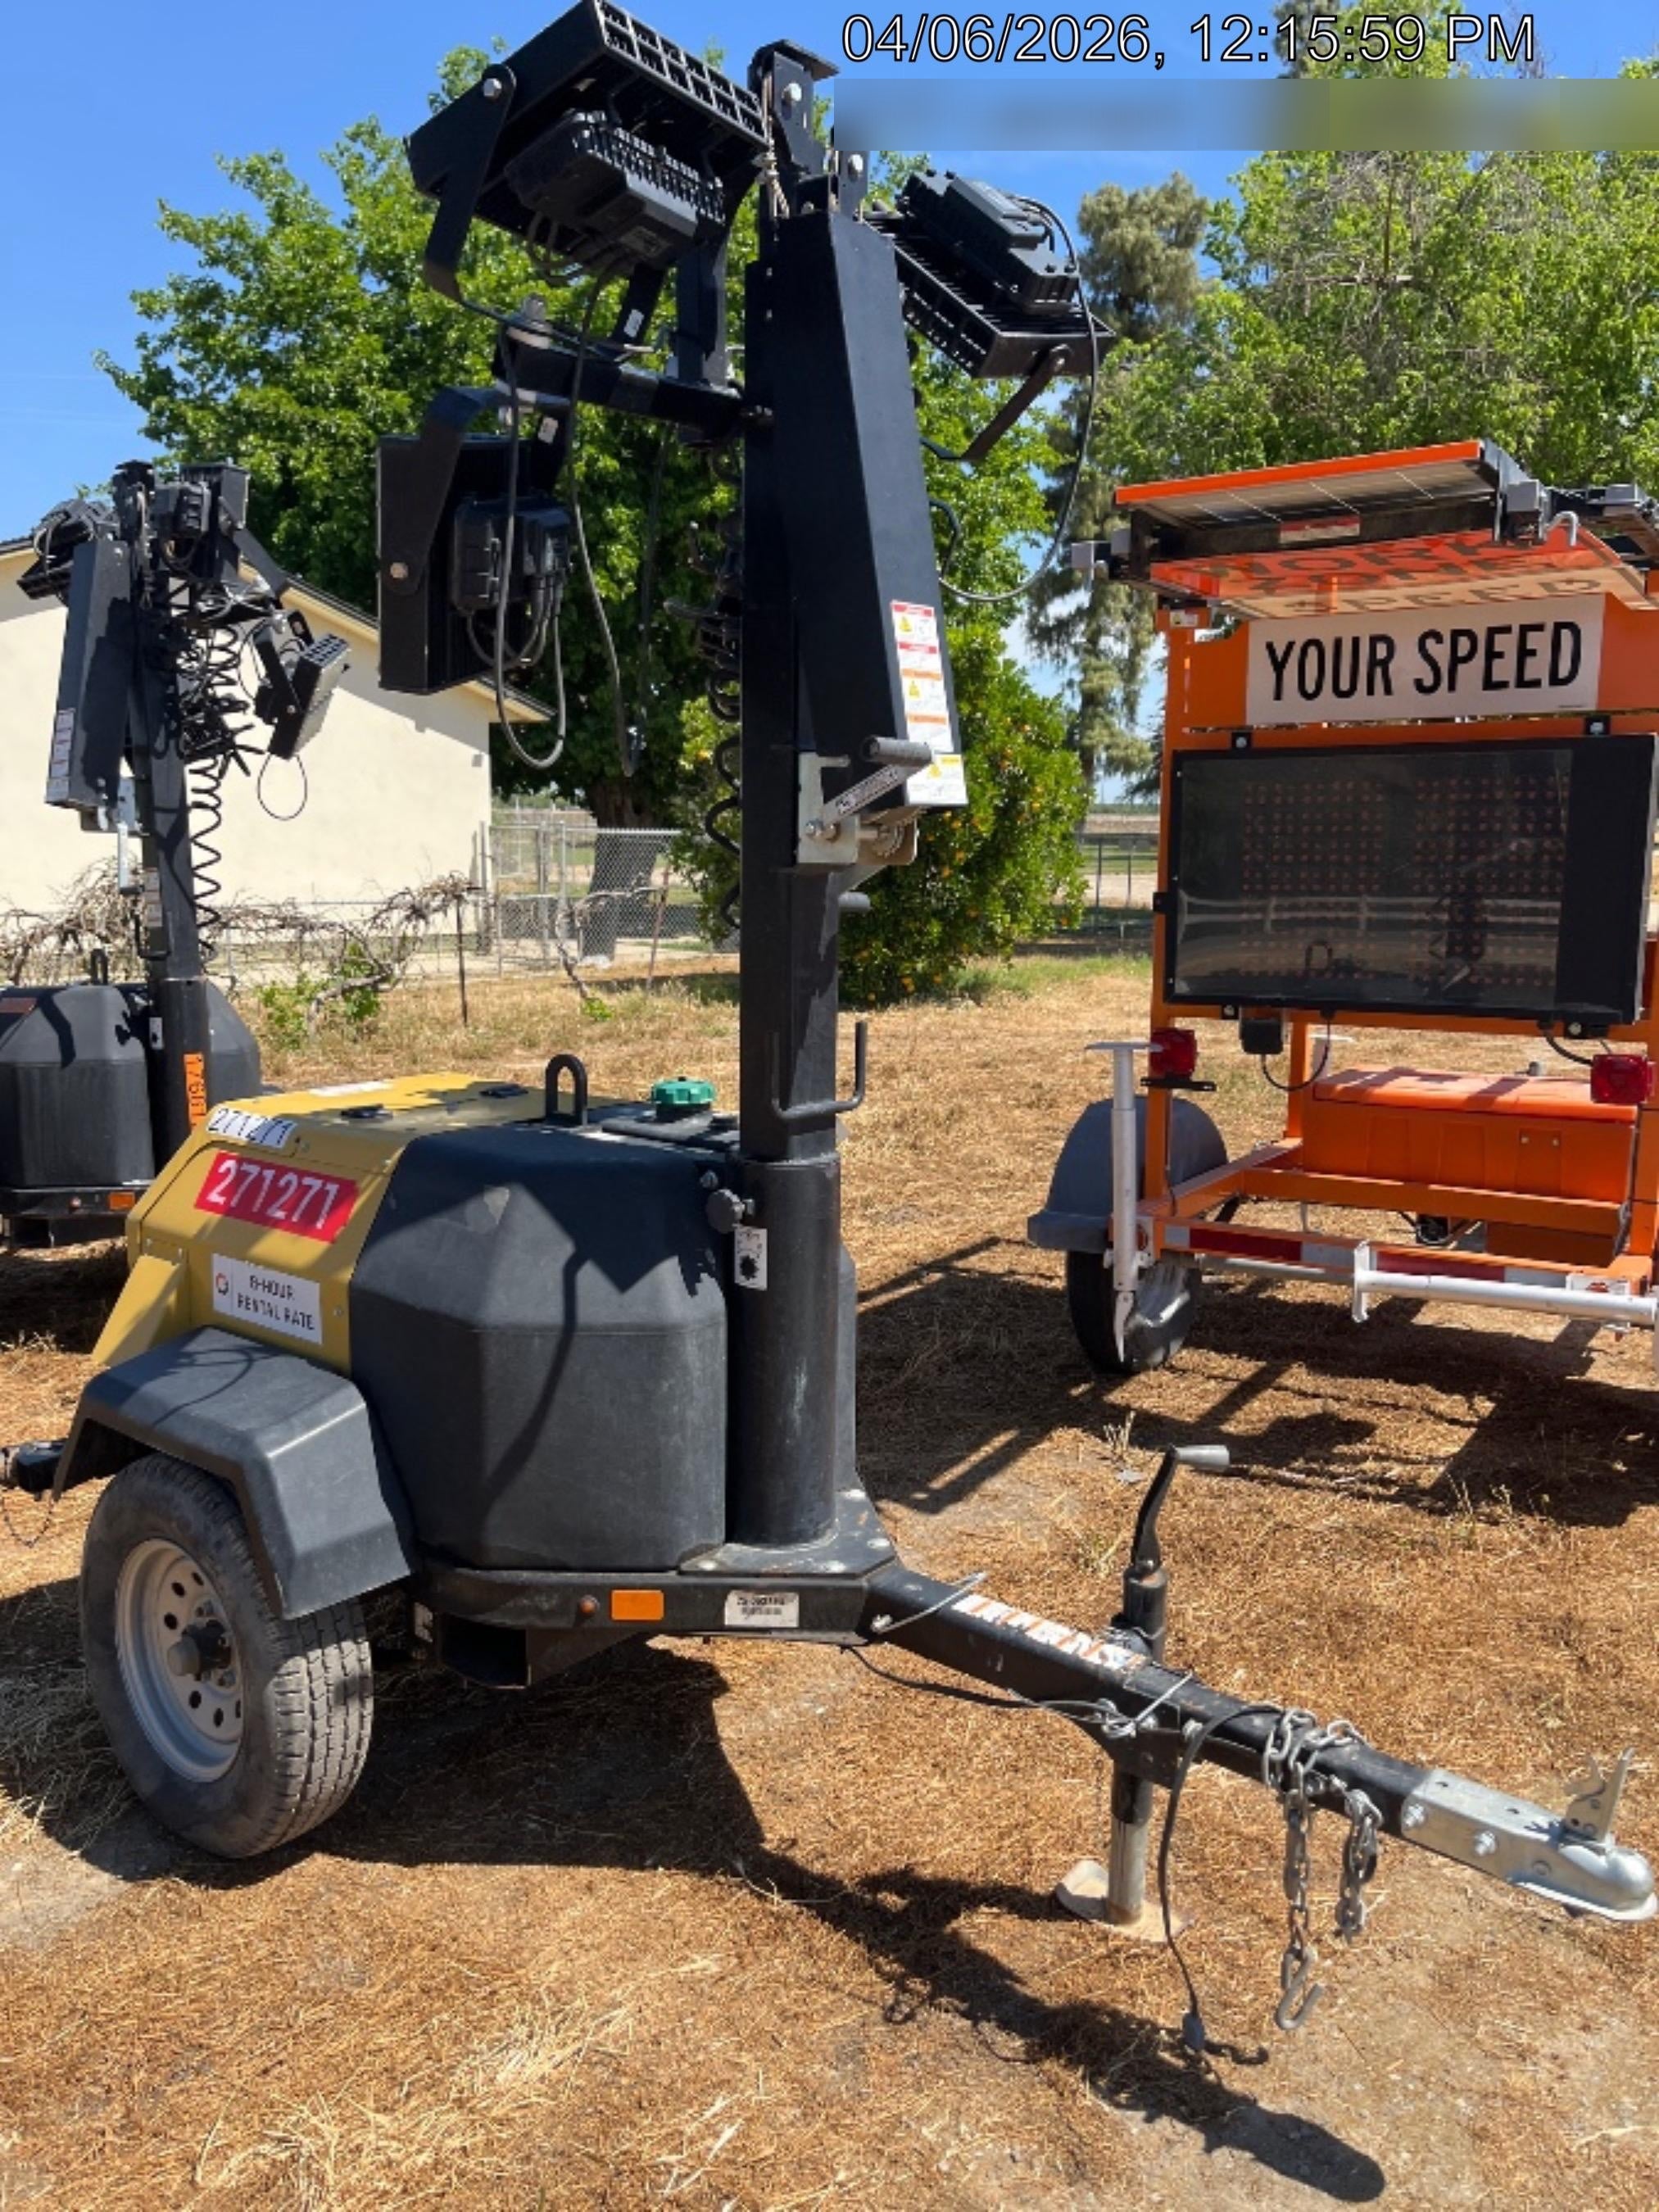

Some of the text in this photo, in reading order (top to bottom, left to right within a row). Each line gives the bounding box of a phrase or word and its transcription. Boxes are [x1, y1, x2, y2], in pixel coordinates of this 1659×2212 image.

[1265, 620, 1582, 701] YOUR SPEED
[208, 1108, 293, 1145] 271271
[206, 1158, 341, 1230] 271271
[237, 1293, 315, 1330] RENTAL RATE
